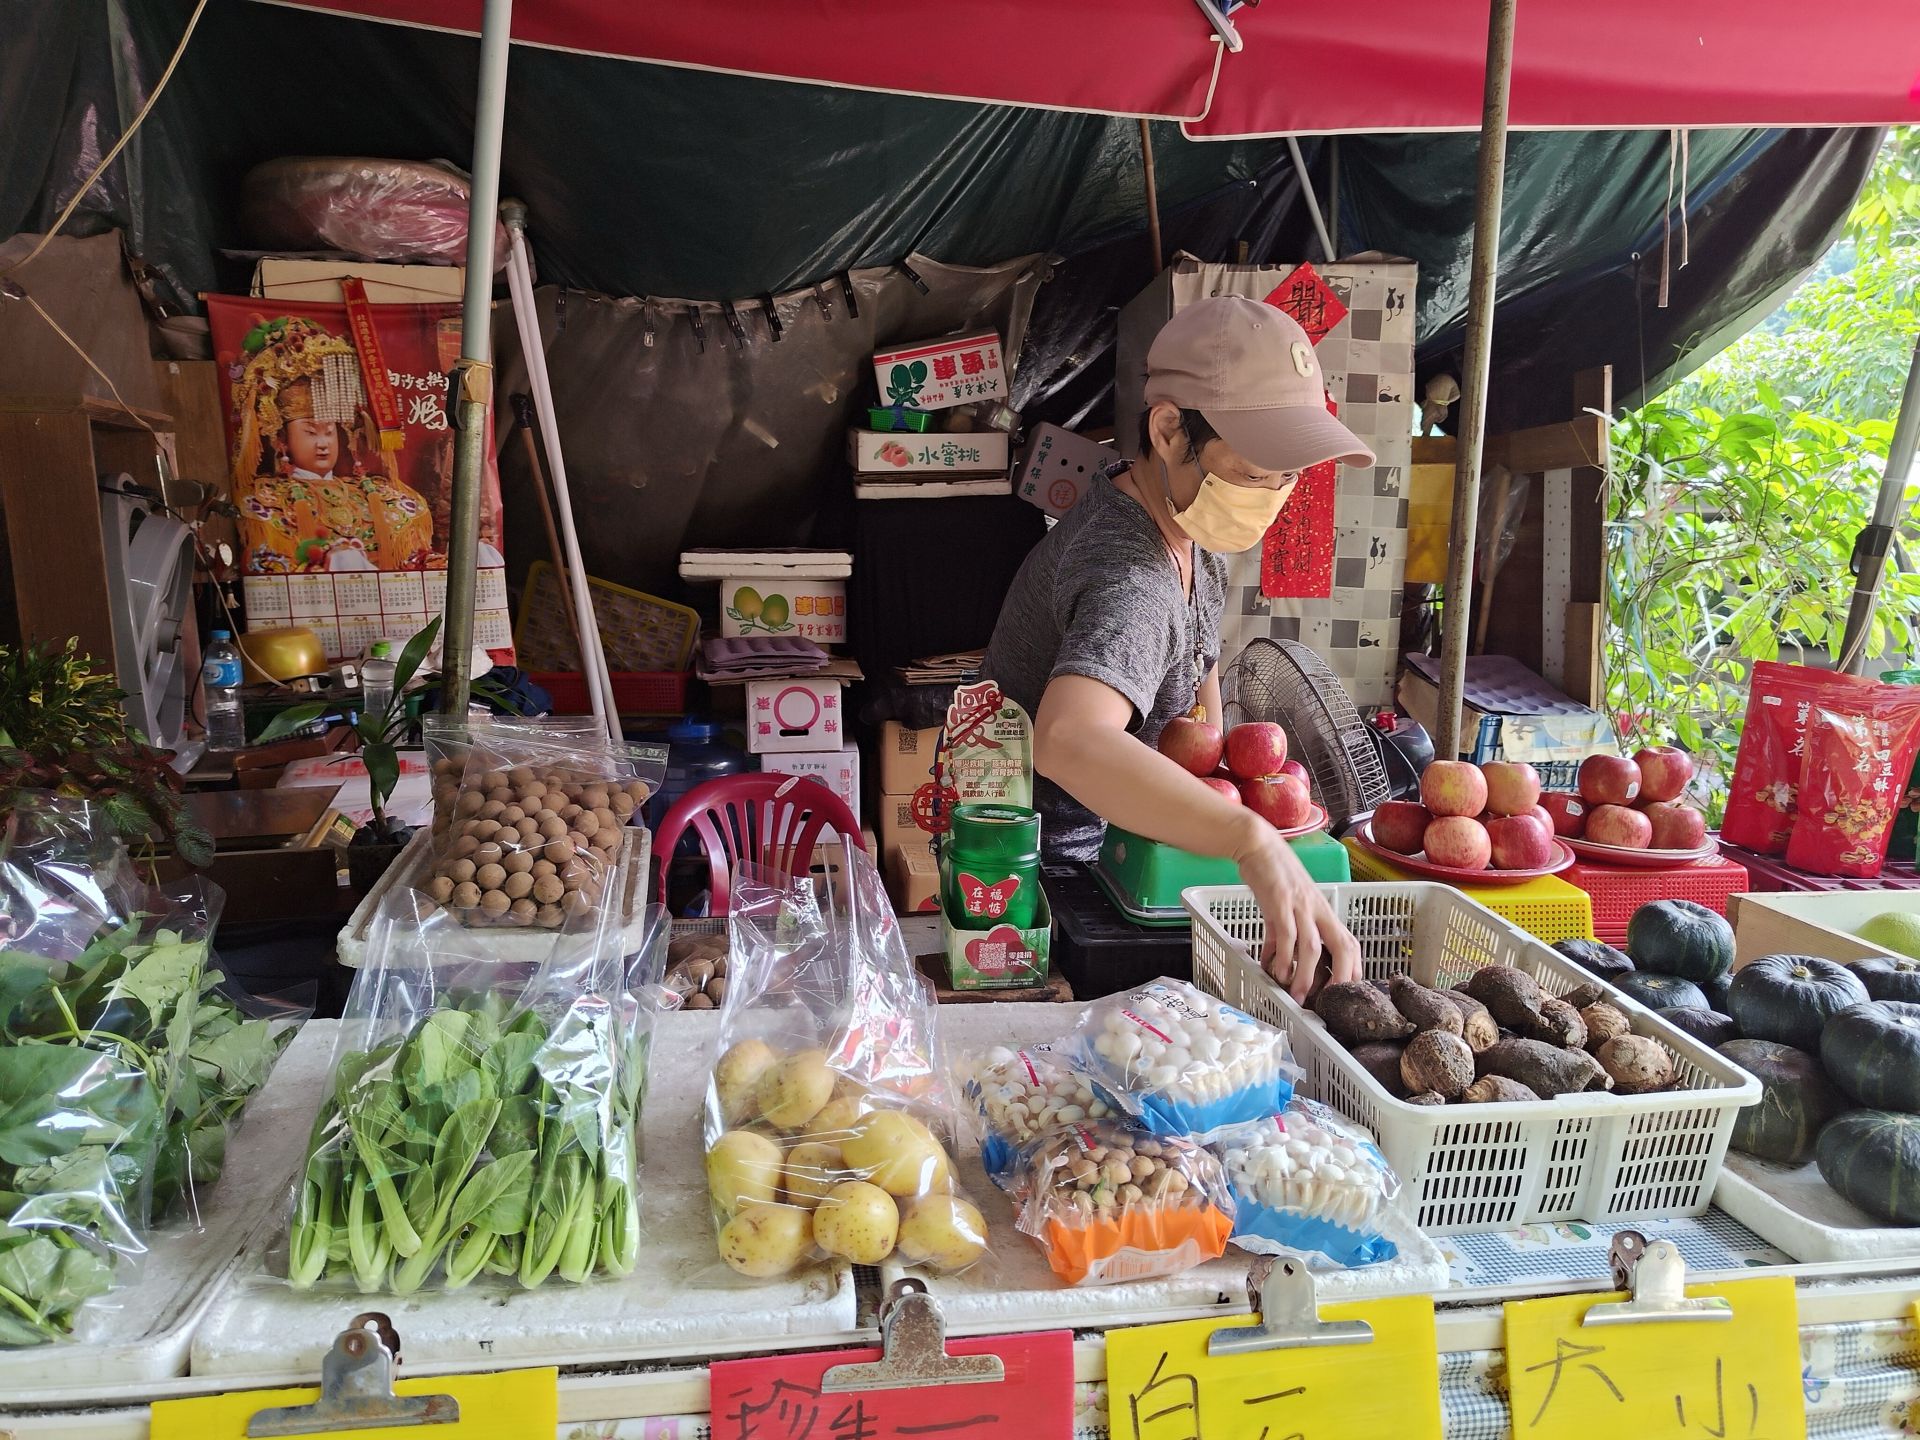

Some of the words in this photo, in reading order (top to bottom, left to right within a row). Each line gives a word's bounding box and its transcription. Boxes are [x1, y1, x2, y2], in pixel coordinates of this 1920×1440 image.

[1291, 340, 1314, 377] C
[918, 441, 980, 466] 水蜜桃
